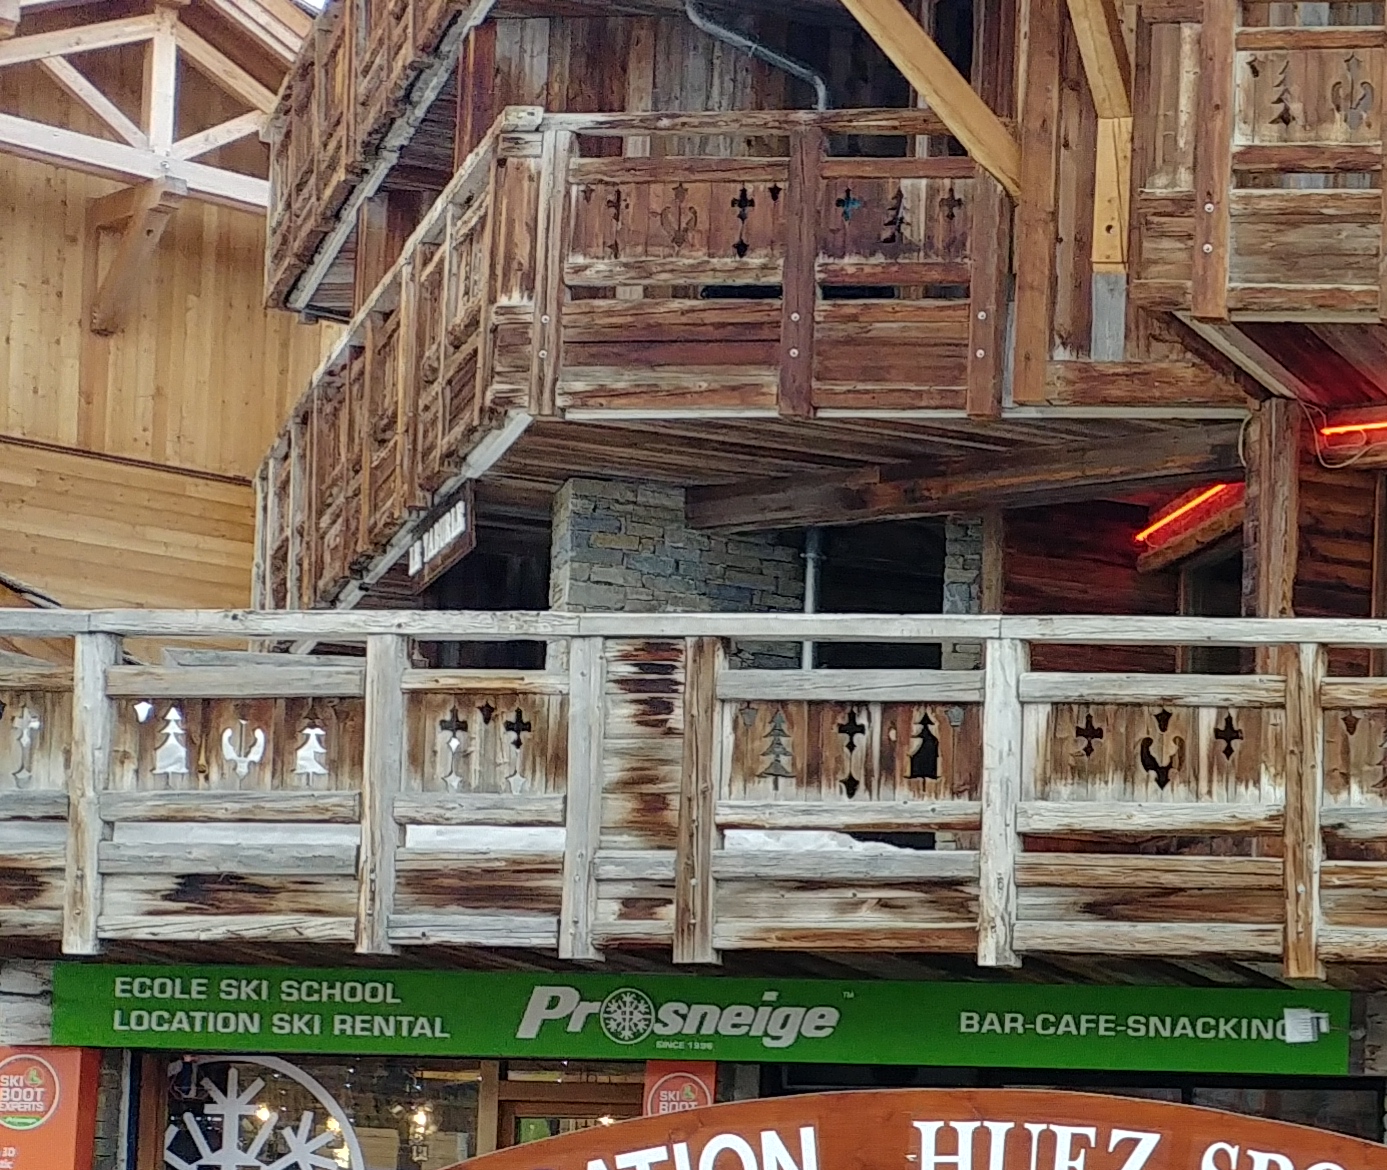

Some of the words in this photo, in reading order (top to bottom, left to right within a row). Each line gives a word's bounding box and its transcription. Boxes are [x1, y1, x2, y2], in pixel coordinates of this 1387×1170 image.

[114, 977, 208, 1000] ECOLE
[223, 979, 271, 1001] SKI
[280, 980, 401, 1004] SCHOOL
[112, 1009, 262, 1034] LOCATION
[272, 1012, 322, 1036] SKI
[332, 1014, 451, 1039] RENTAL
[0, 1075, 24, 1087] SKI
[0, 1088, 44, 1102] BOOT
[659, 1090, 680, 1102] SKI
